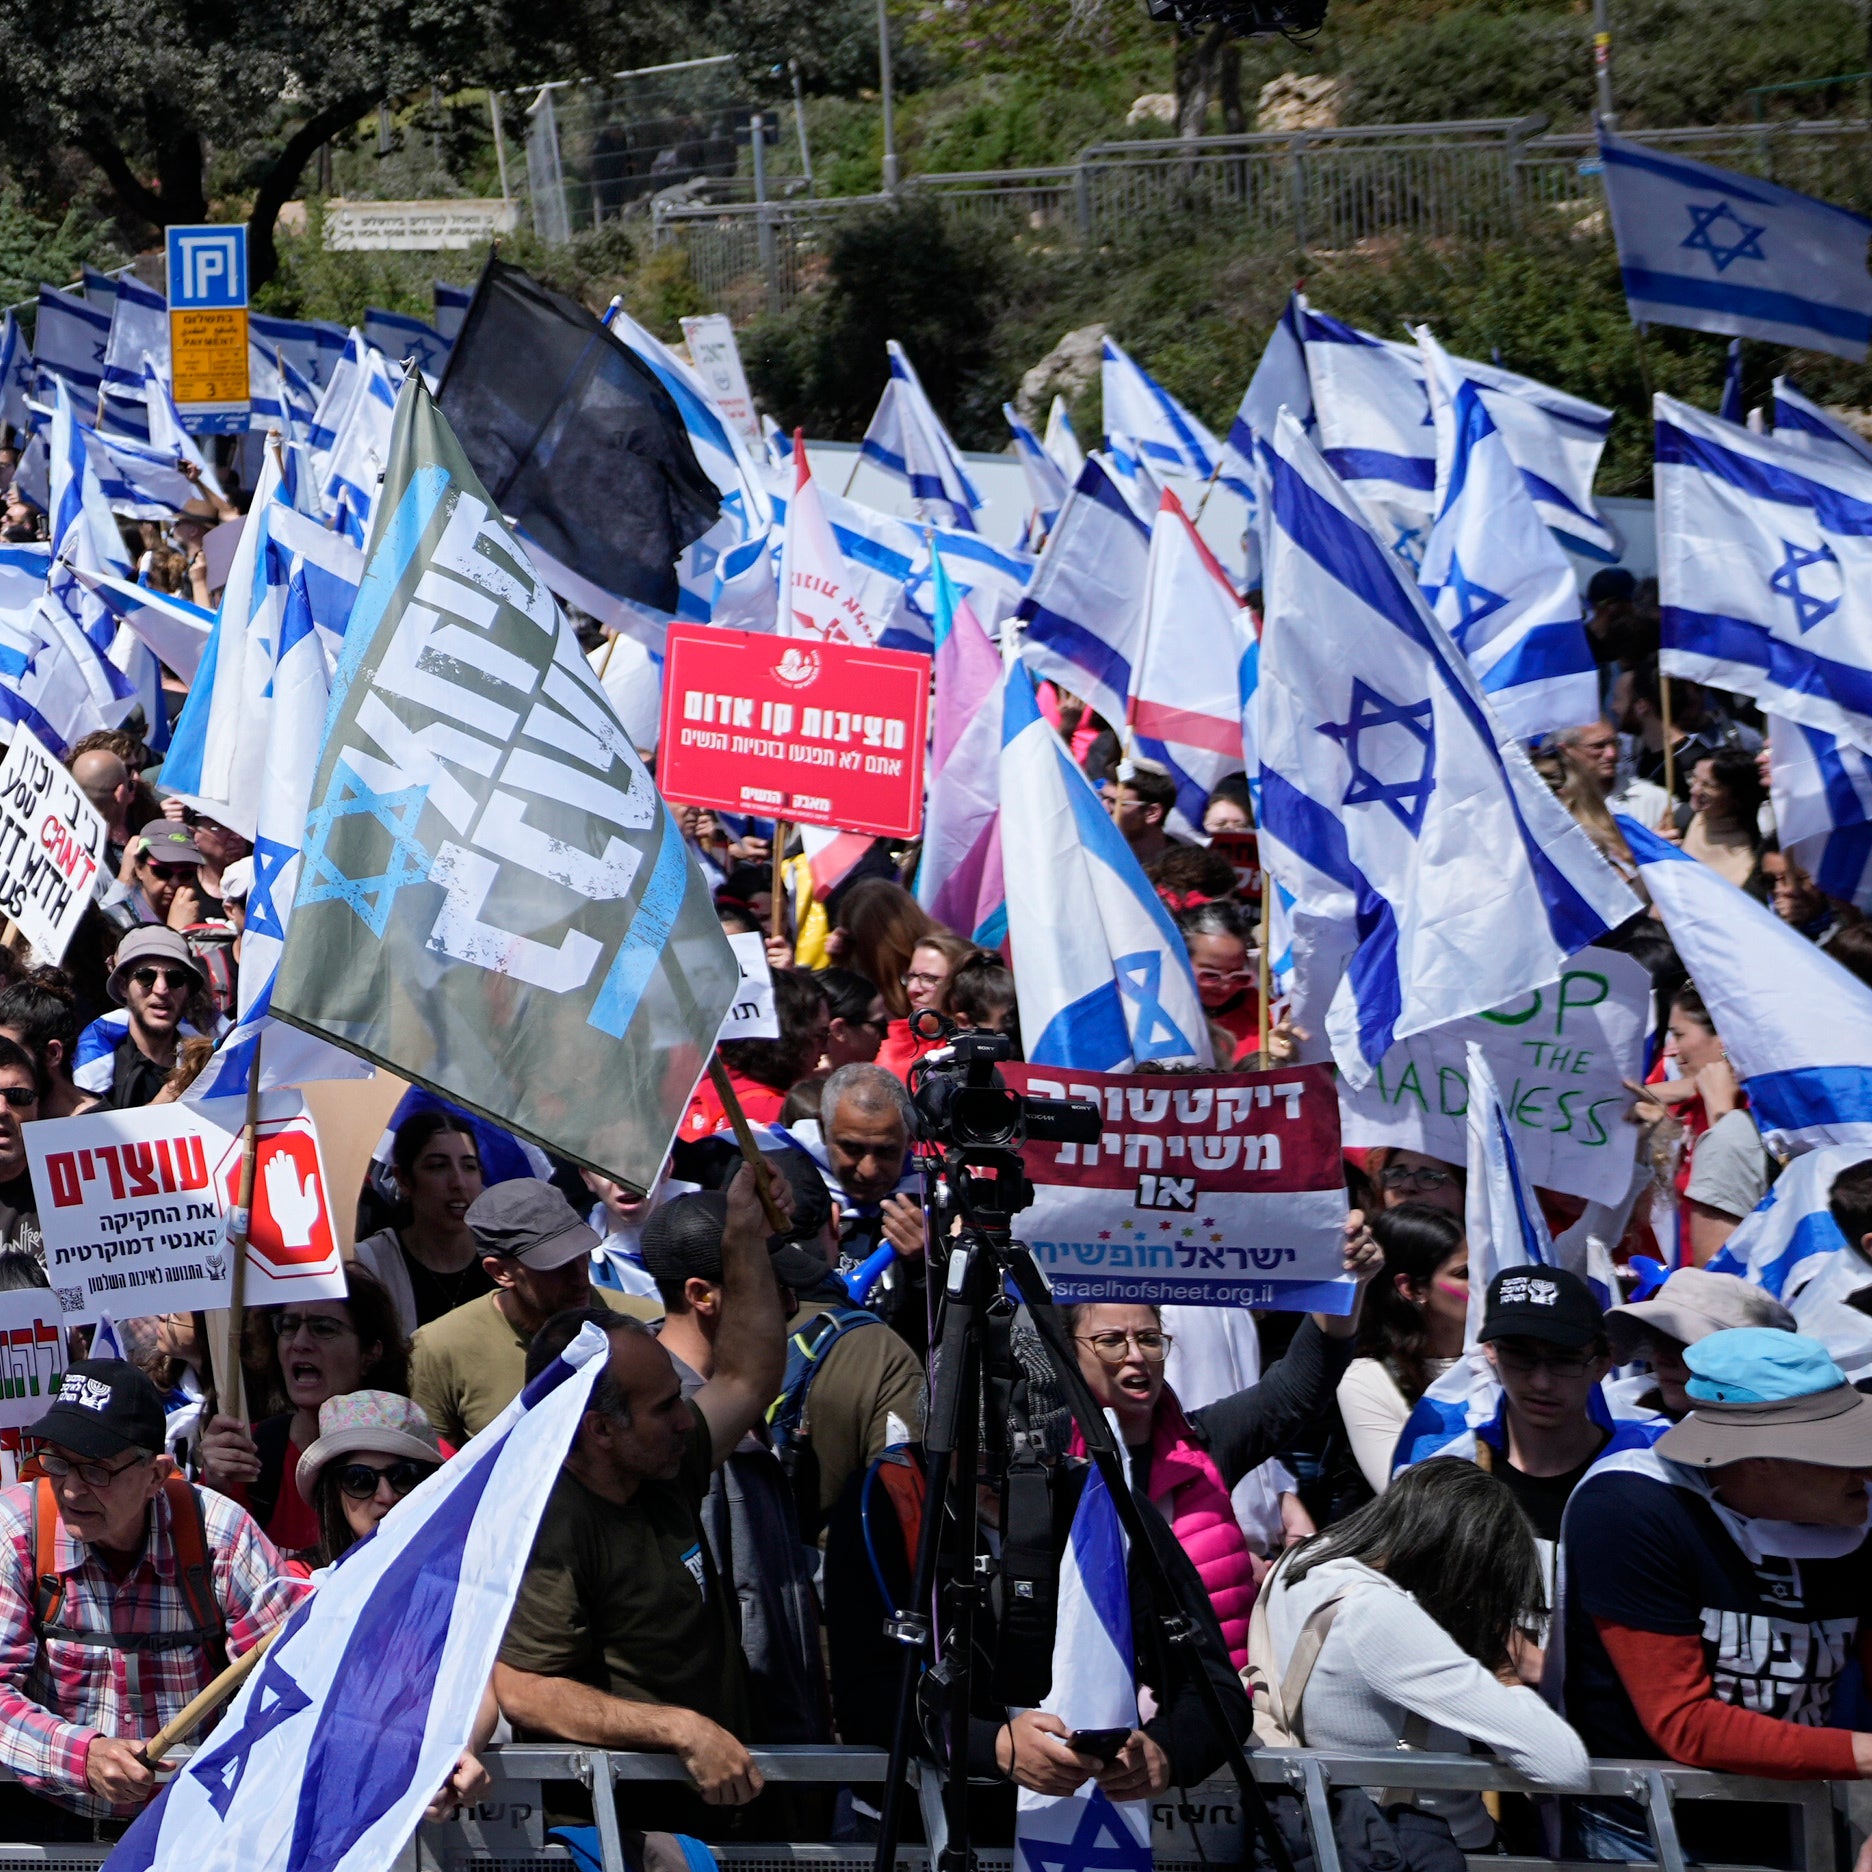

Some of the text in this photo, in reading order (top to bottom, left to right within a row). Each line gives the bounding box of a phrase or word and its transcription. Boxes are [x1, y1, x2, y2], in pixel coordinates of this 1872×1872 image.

[182, 336, 235, 347] PAYMENT
[207, 383, 216, 397] 3
[683, 690, 906, 750] מציבות קו אדום
[680, 728, 902, 776] אתם לא תפגעו בזכויות הנשים
[740, 786, 830, 811] מאבק הנשים
[64, 784, 98, 859] ביבי
[41, 815, 97, 891] CAN'T
[21, 842, 73, 930] WITH
[1522, 1041, 1595, 1074] THE
[1333, 1061, 1623, 1146] ADESS
[44, 1135, 208, 1208] עוצרים
[1139, 1174, 1195, 1207] או
[99, 1202, 216, 1235] את החקיקה
[55, 1235, 154, 1265] דמוקרטית
[160, 1228, 217, 1250] האנטי
[87, 1263, 204, 1295] התנועה לאיכות השלטון
[1051, 1279, 1273, 1306] israelhofsheet.org.il
